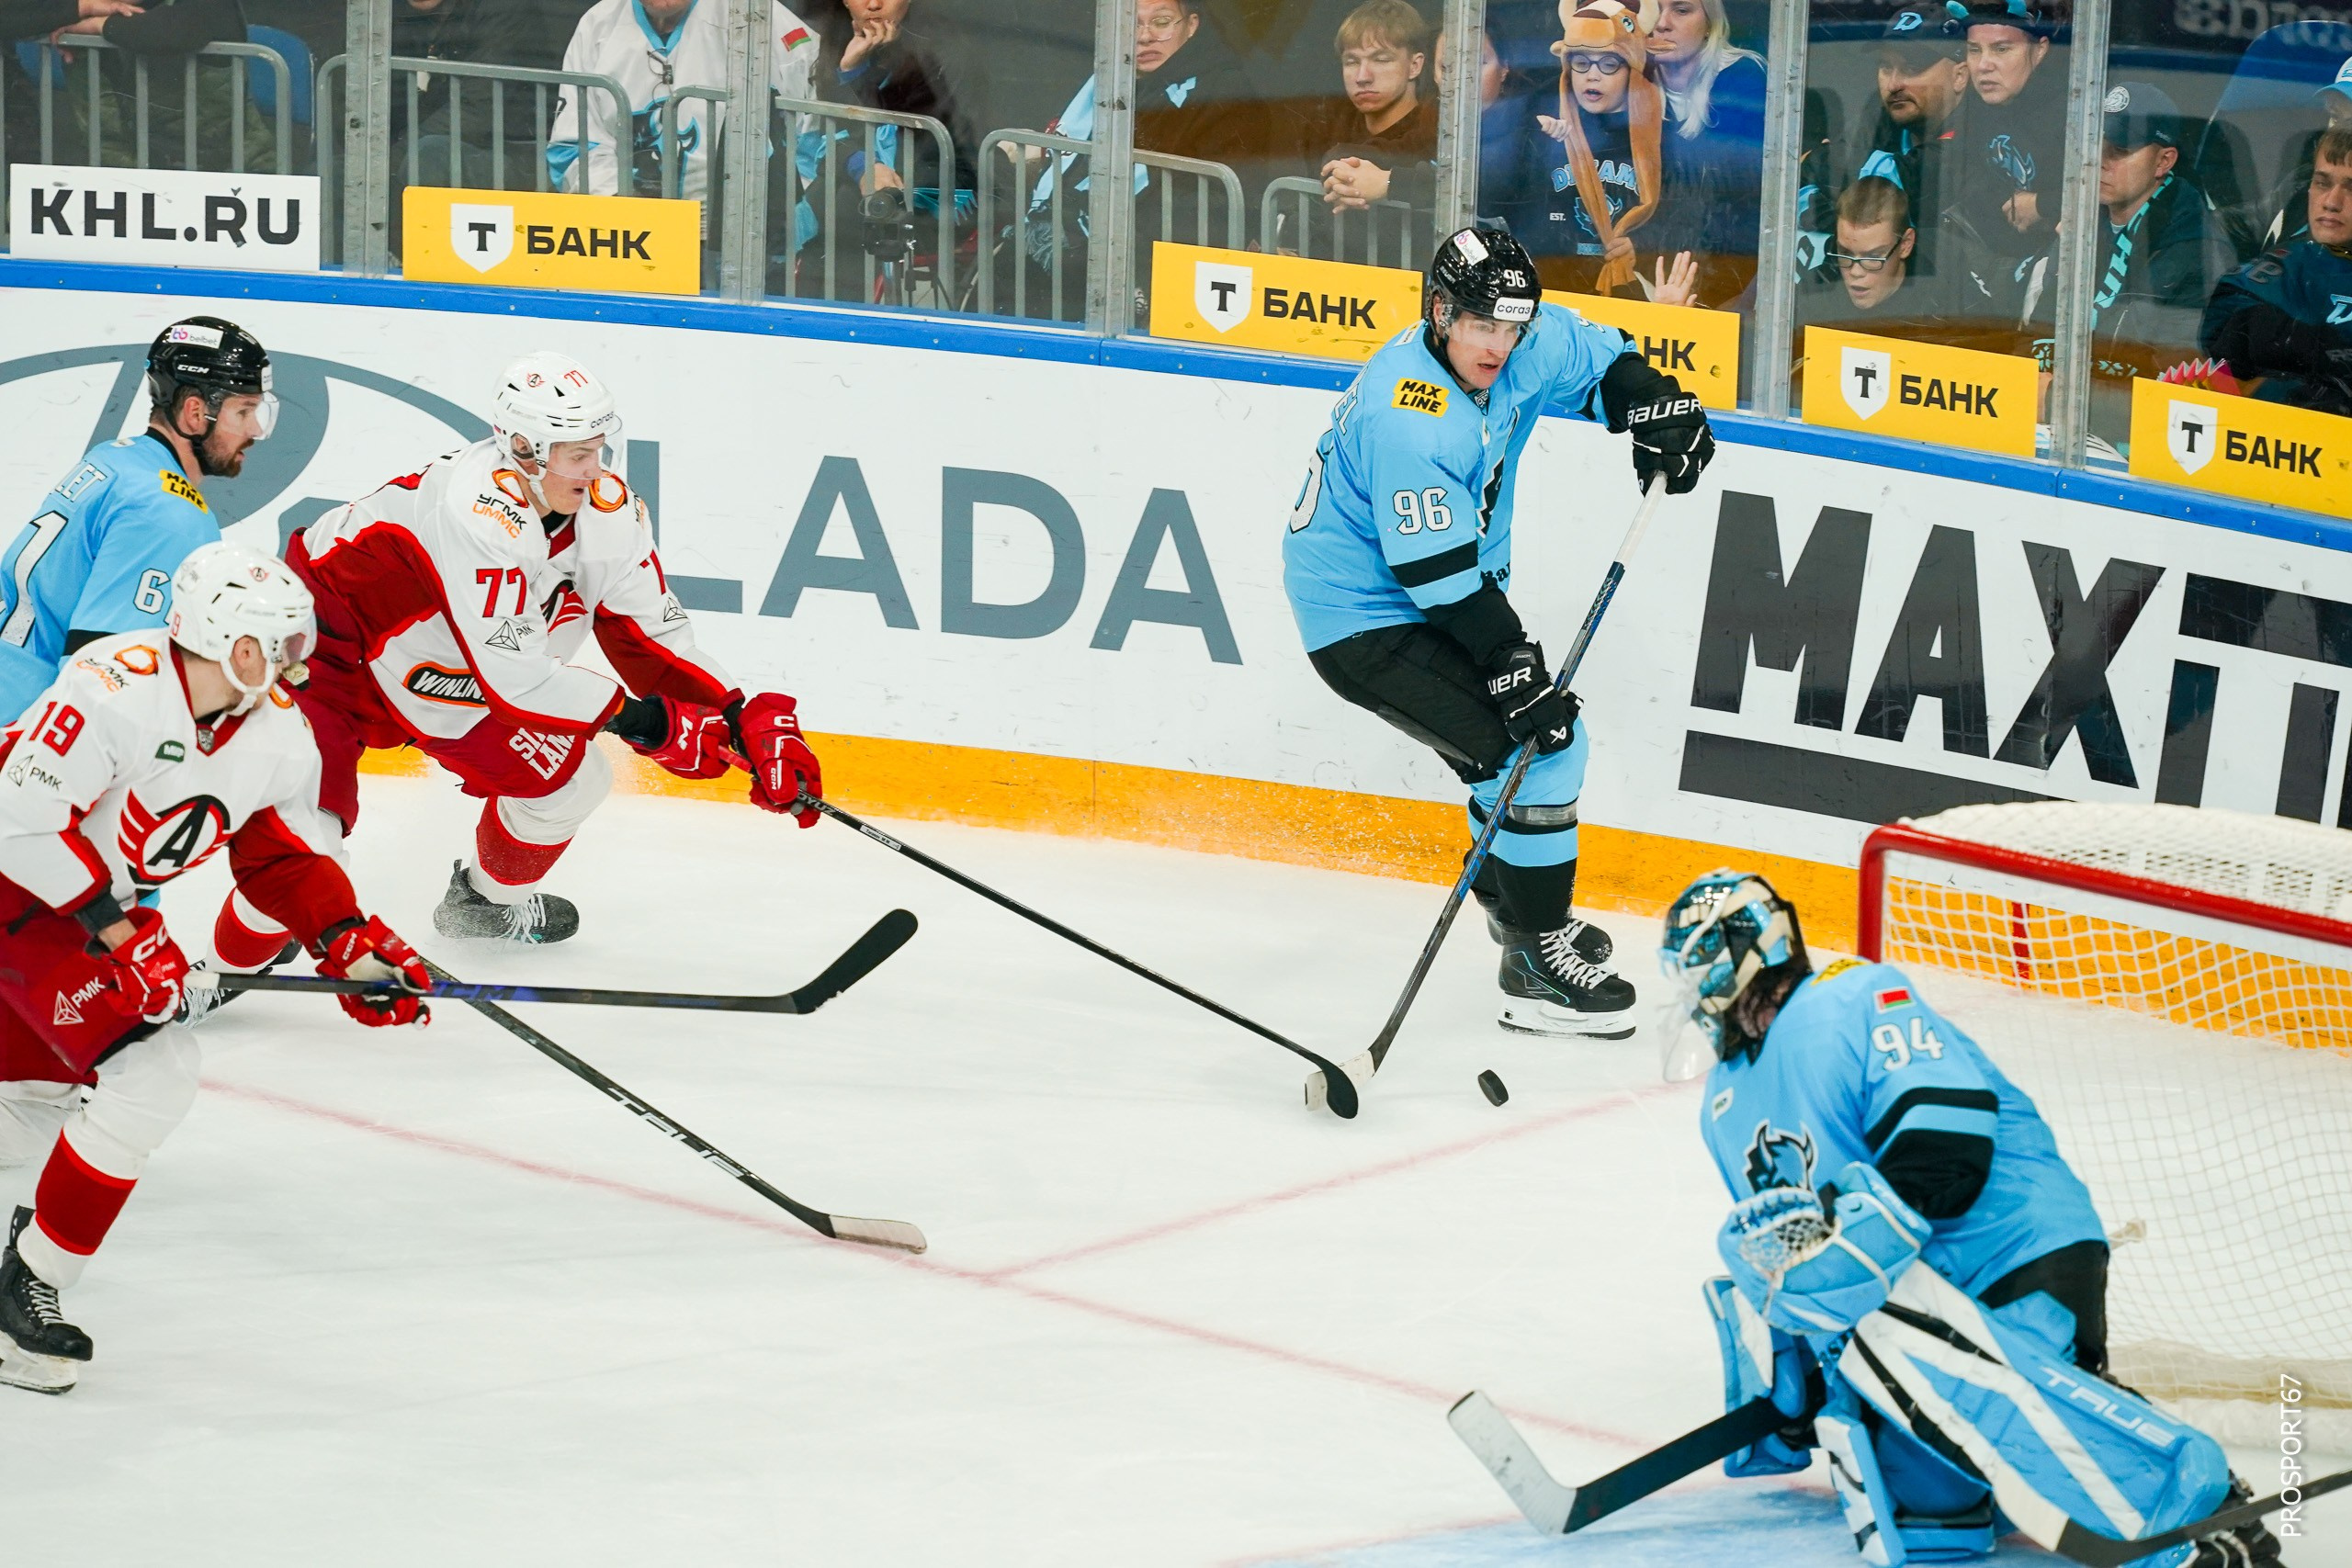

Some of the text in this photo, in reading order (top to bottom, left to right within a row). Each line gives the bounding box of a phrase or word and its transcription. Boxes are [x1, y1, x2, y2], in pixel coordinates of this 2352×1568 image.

[31, 187, 300, 247] KHL.RU
[1549, 212, 1566, 220] EST.
[526, 224, 651, 260] БАНК
[1503, 269, 1526, 288] 96
[1263, 287, 1376, 329] БАНК
[1497, 304, 1531, 314] согаз
[177, 364, 209, 374] CCM
[1643, 335, 1697, 372] НК
[564, 369, 588, 388] 77
[1400, 380, 1442, 399] MAX
[1900, 374, 1999, 418] БАНК
[1399, 394, 1442, 413] LINE
[2225, 429, 2323, 478] БАНК
[170, 482, 204, 509] LINE
[1392, 487, 1453, 536] 96
[472, 502, 521, 539] UMMC
[627, 438, 1243, 666] LADA
[475, 567, 527, 618] 77
[1690, 490, 2166, 789] MAX
[413, 671, 486, 701] WINLIN
[28, 701, 85, 757] 19
[342, 931, 357, 961] CCM
[1871, 1017, 1945, 1072] 94
[2040, 1366, 2176, 1448] TRUE
